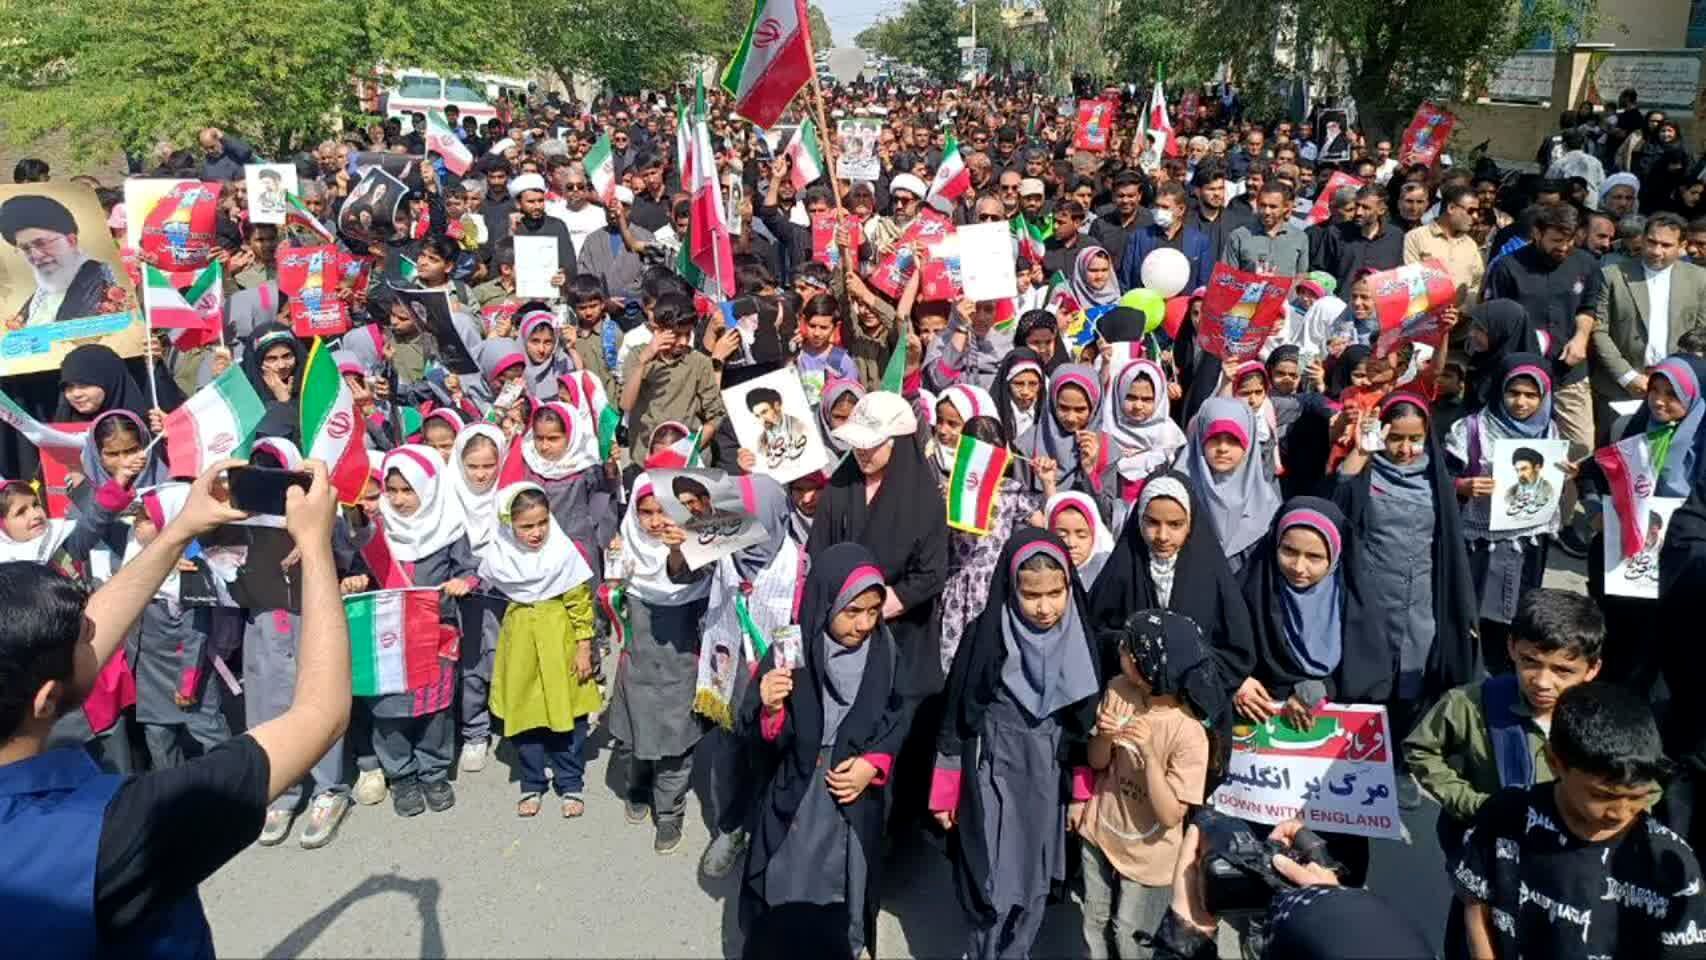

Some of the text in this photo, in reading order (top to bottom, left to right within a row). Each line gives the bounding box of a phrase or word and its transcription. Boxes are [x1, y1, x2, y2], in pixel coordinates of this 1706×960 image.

[1300, 776, 1321, 800] بر
[1329, 770, 1390, 806] مرگ
[1218, 793, 1393, 829] DOWN WITH ENGLAND
